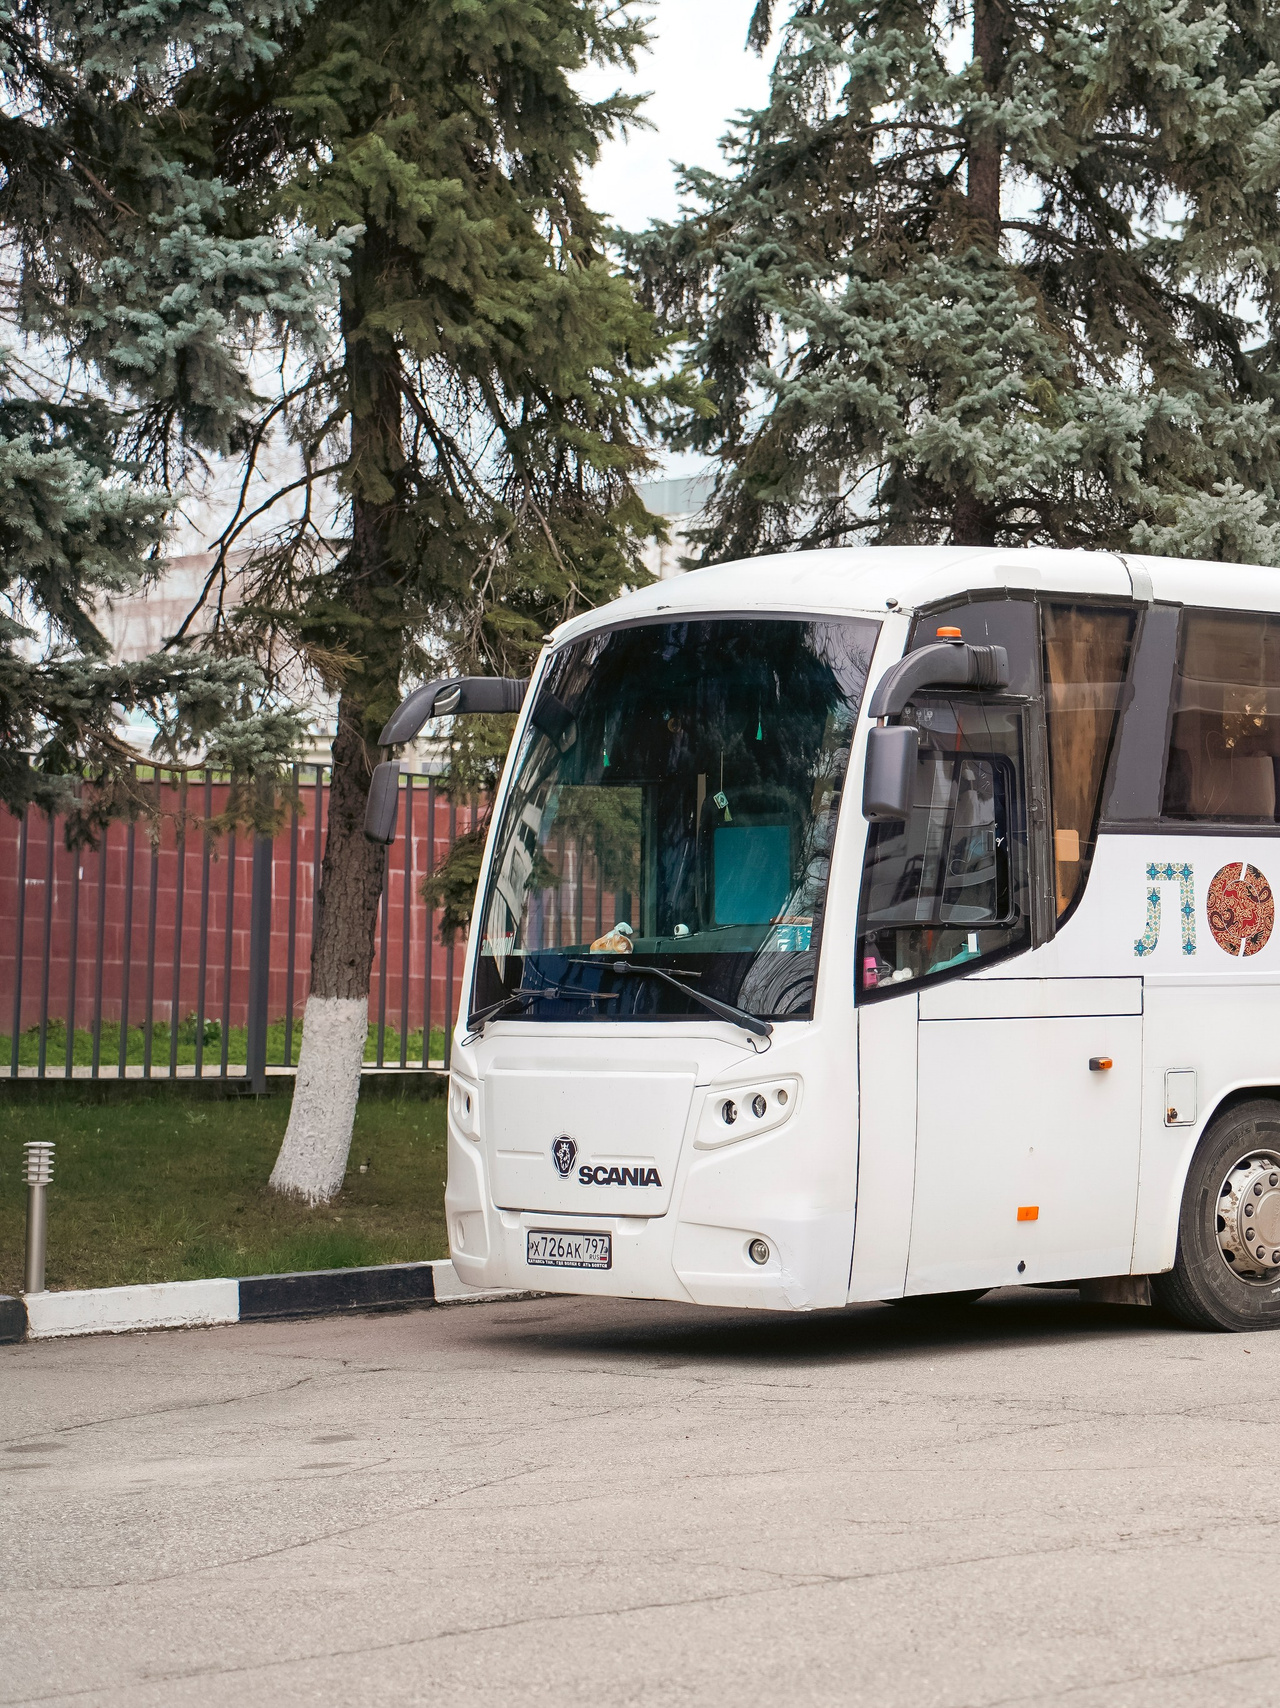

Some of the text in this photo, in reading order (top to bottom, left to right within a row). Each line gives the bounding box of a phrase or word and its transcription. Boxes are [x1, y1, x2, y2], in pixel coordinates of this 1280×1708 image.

[578, 1165, 662, 1187] SCANIA
[585, 1238, 605, 1254] 797
[589, 1253, 600, 1261] RUS
